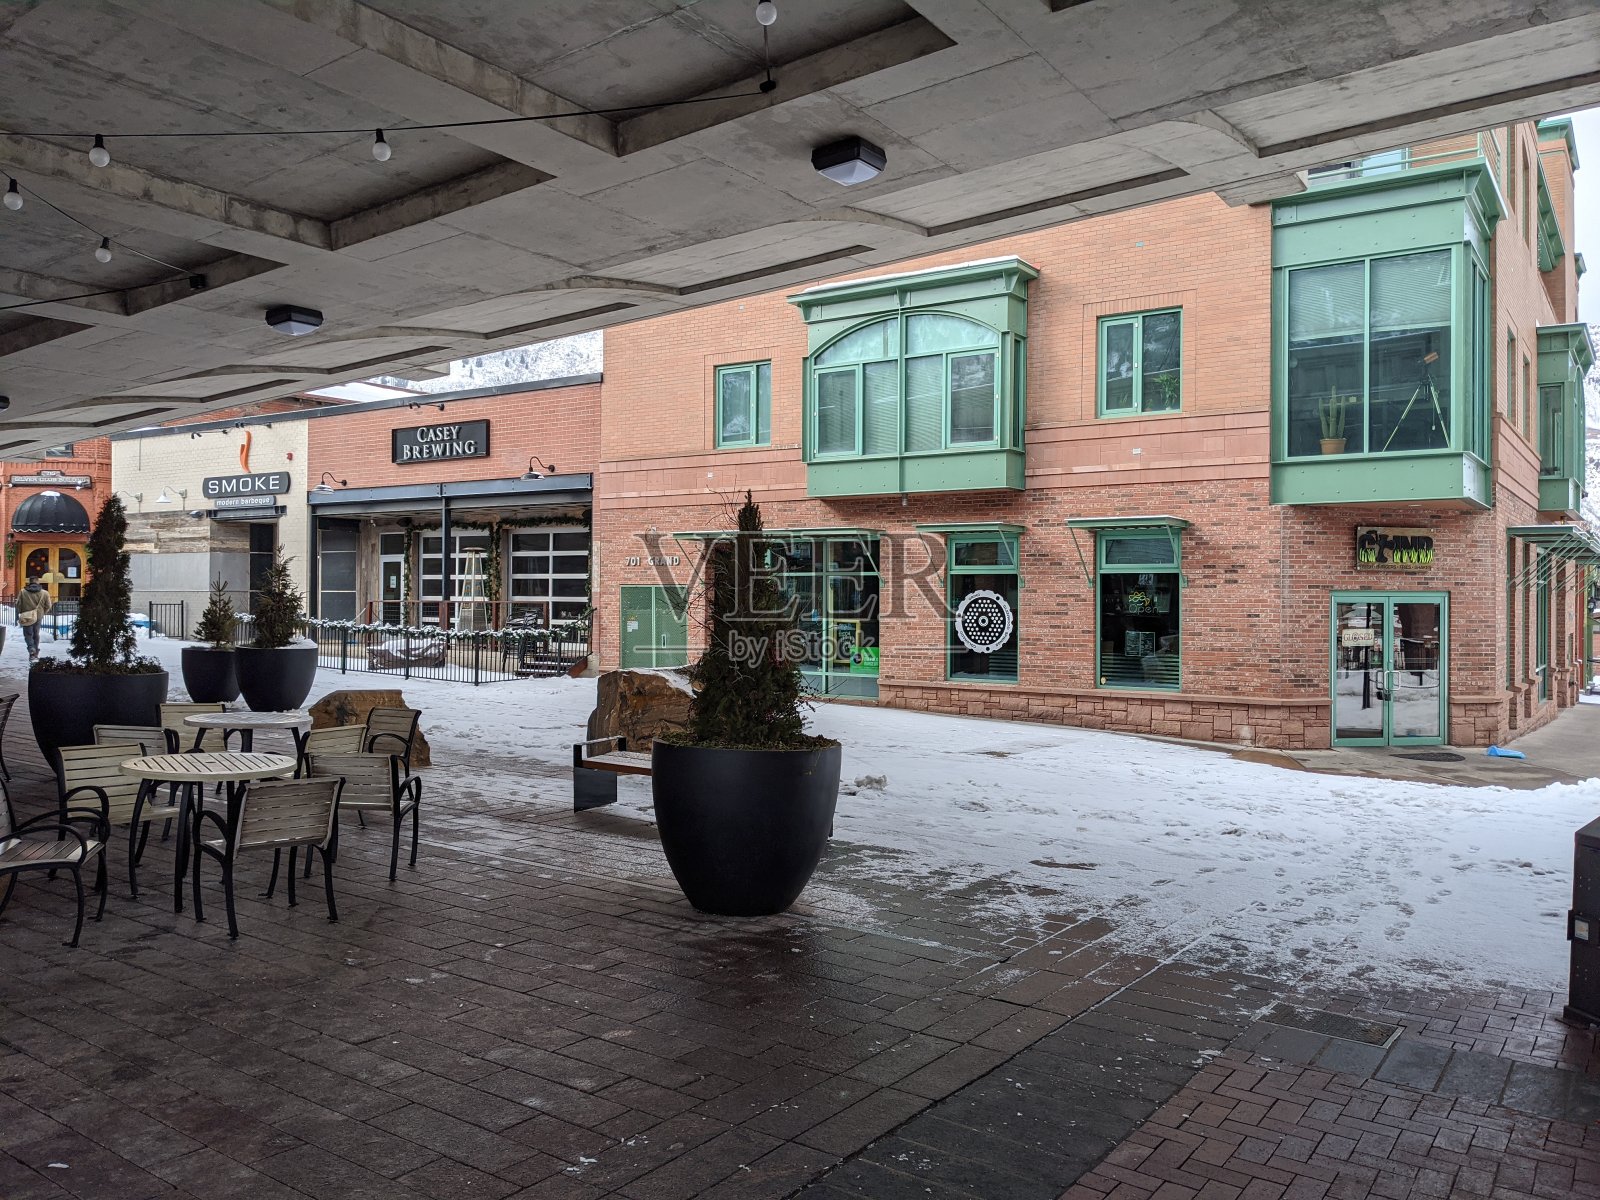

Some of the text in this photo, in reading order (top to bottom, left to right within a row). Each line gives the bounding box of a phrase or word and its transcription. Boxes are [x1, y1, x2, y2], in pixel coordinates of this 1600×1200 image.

[416, 425, 460, 443] CASEY
[402, 440, 476, 460] BREWING
[208, 475, 280, 494] SMOKE
[240, 497, 270, 506] barbeque
[625, 556, 681, 566] 701 GRAND
[1128, 603, 1159, 615] Open
